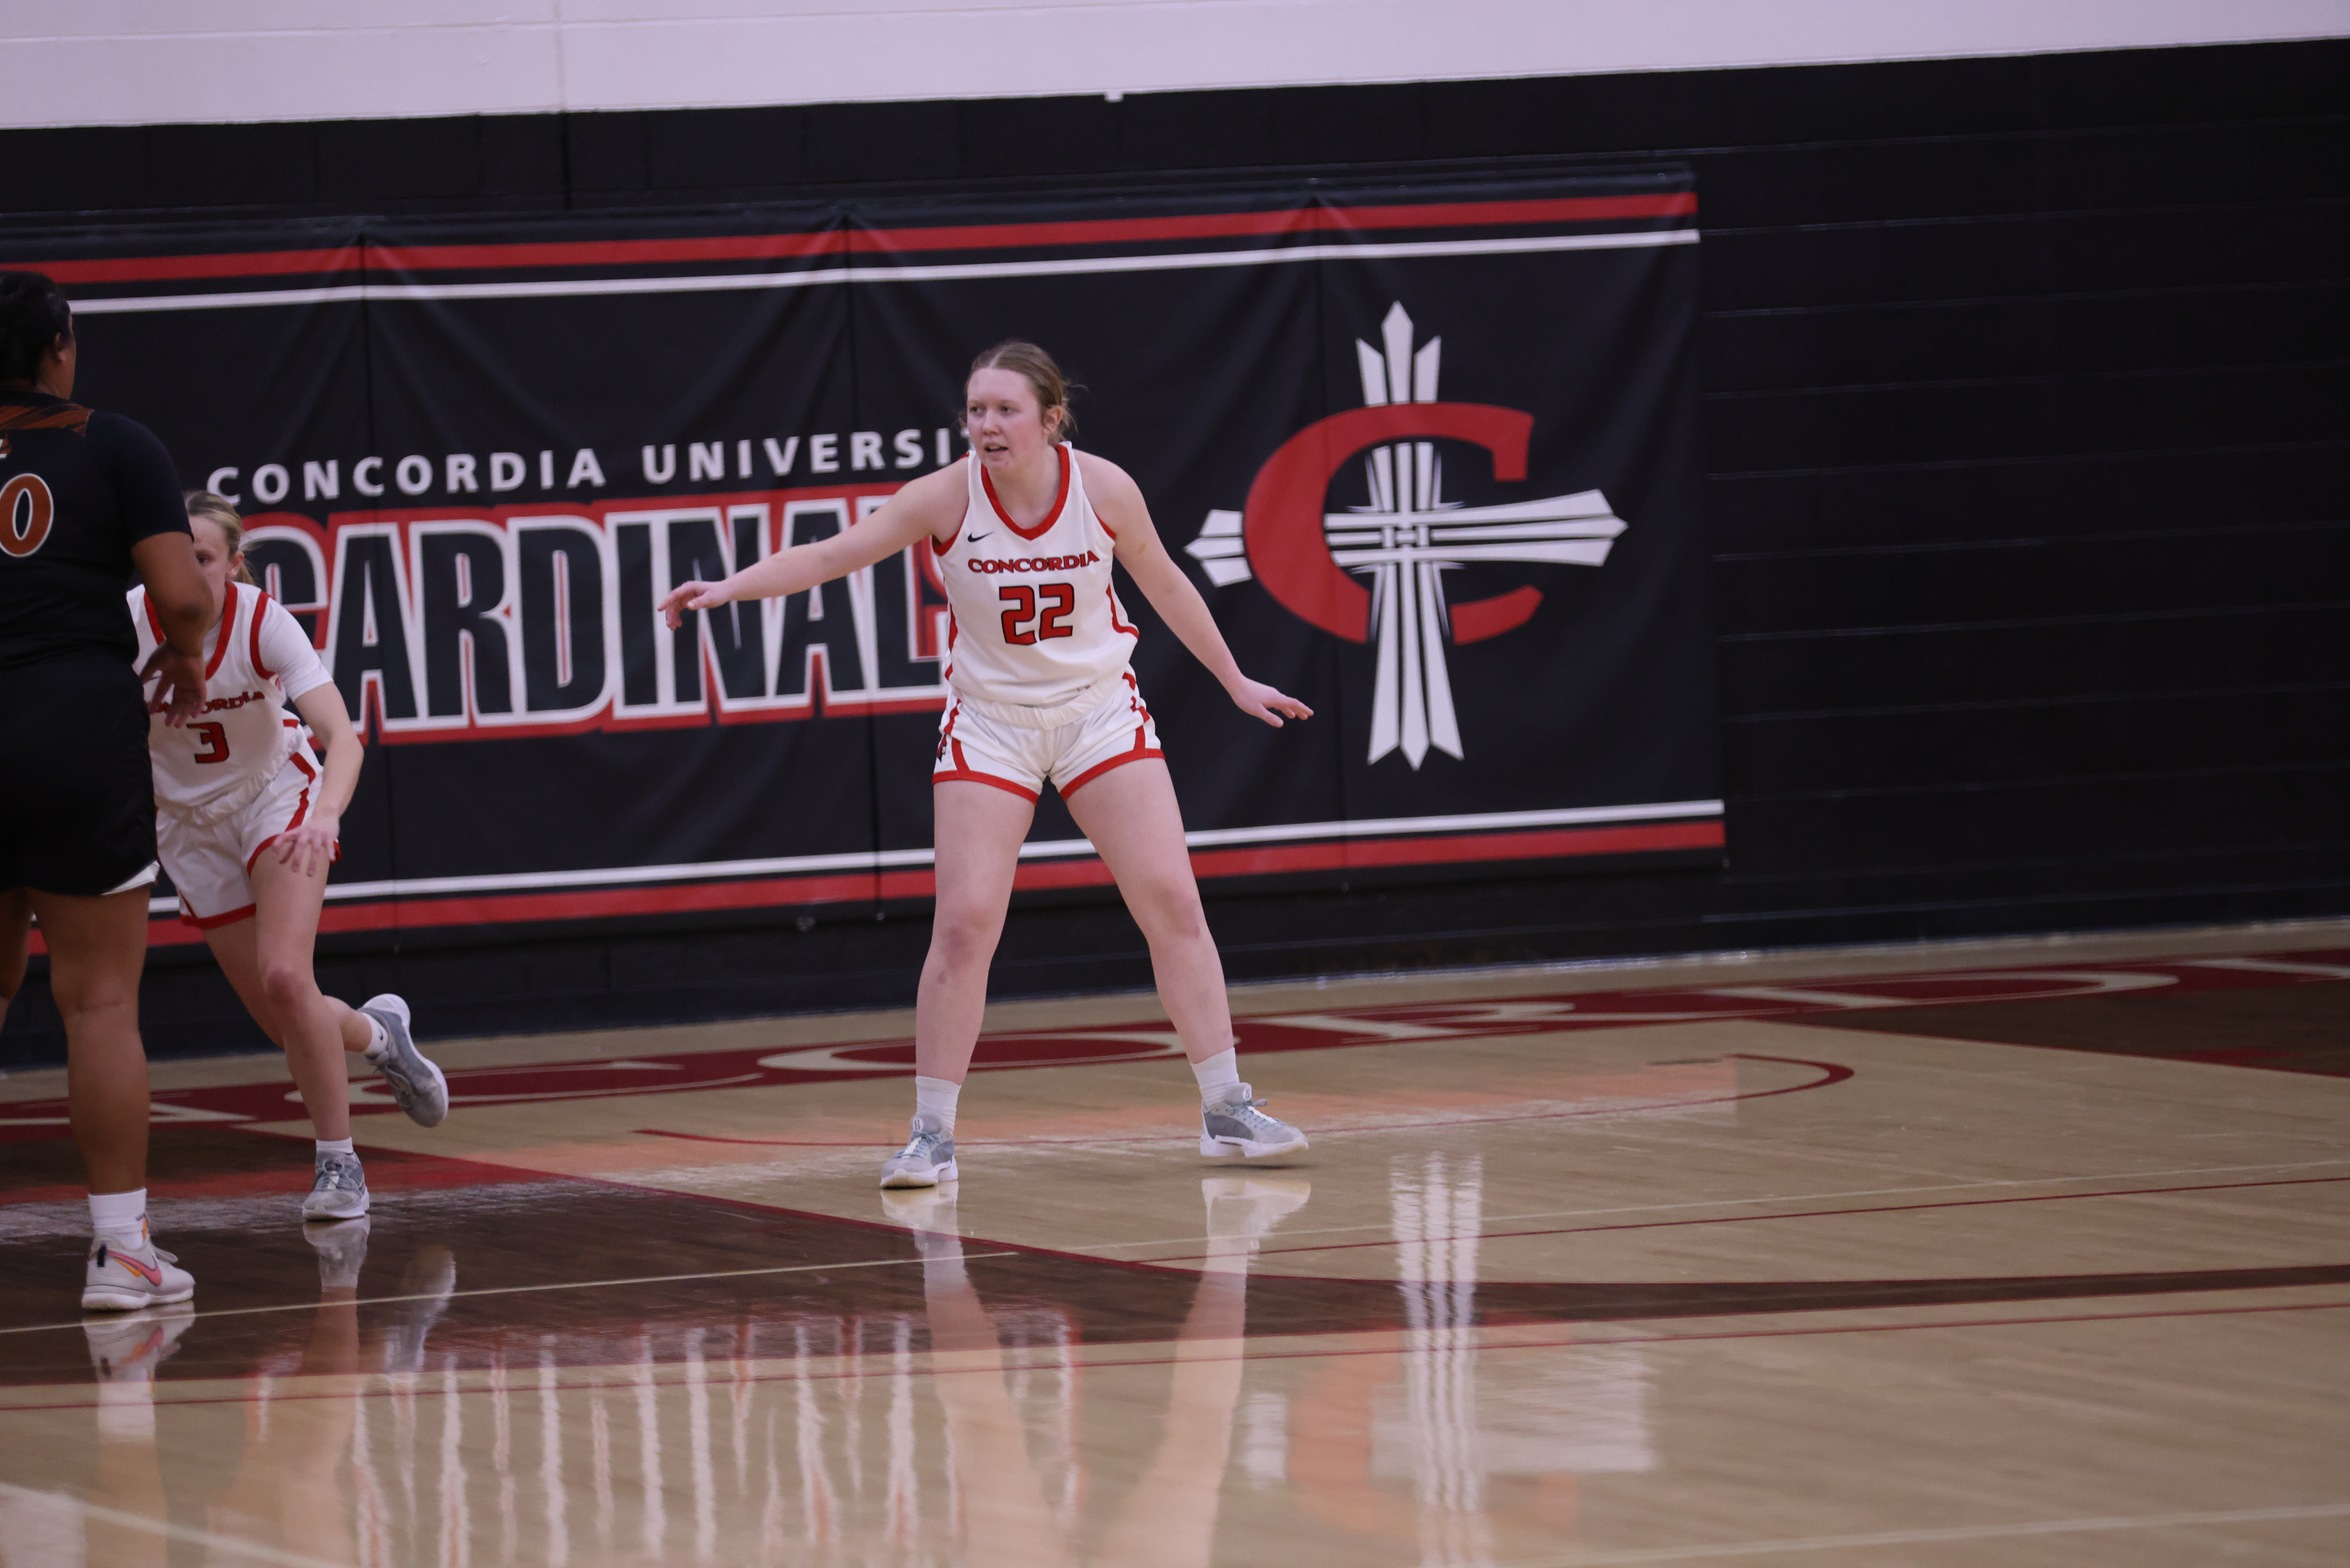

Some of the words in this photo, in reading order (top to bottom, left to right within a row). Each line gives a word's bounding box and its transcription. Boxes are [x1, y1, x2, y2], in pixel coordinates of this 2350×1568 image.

[206, 447, 606, 504] CONCORDIA
[641, 427, 969, 485] UNIVERSI
[967, 550, 1101, 574] CONCORDIA
[240, 483, 949, 747] ARDINAL
[999, 582, 1075, 646] 22
[186, 721, 230, 764] 3
